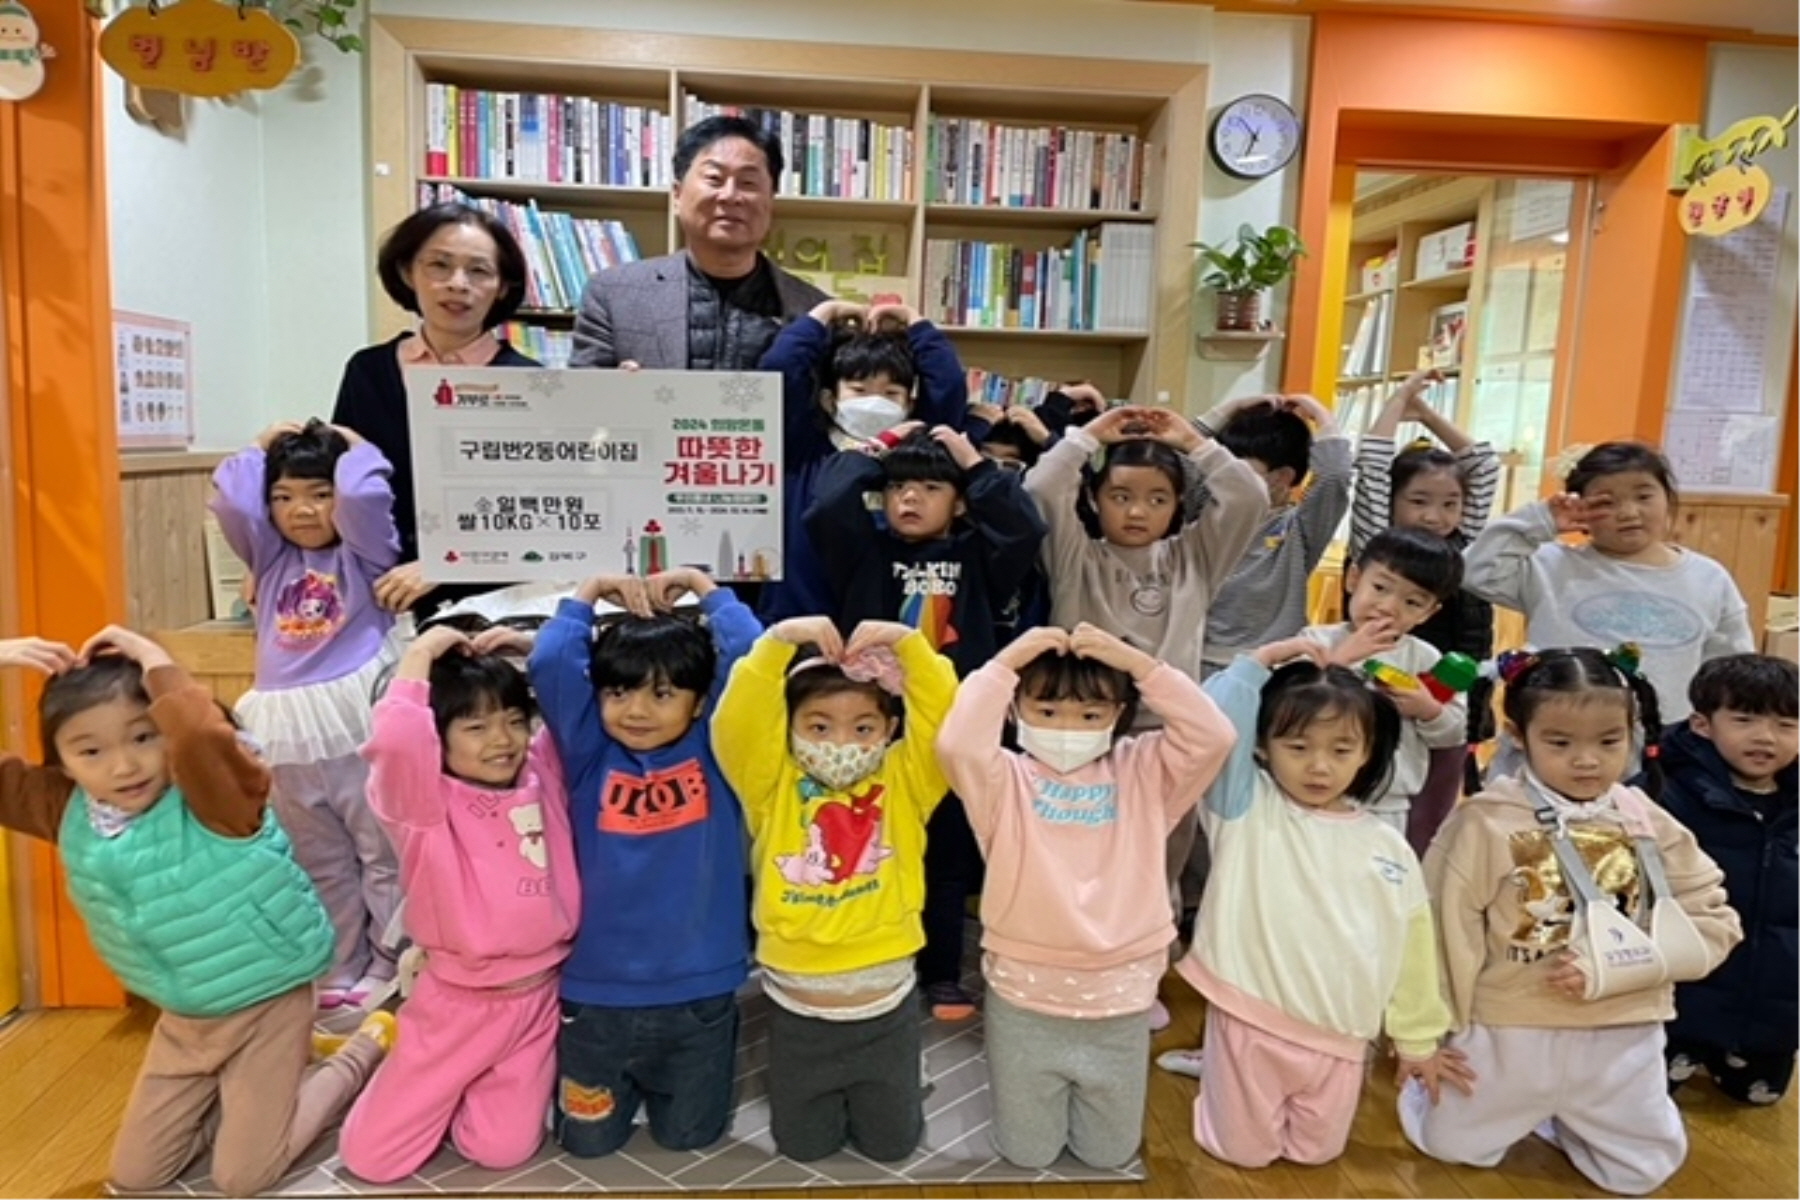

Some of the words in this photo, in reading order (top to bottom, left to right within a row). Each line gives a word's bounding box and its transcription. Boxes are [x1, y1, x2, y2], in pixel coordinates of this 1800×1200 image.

[672, 418, 707, 430] 2024
[459, 441, 639, 461] 구립번2동어린이집
[677, 436, 762, 459] 따뜻한
[664, 462, 775, 486] 겨울나기
